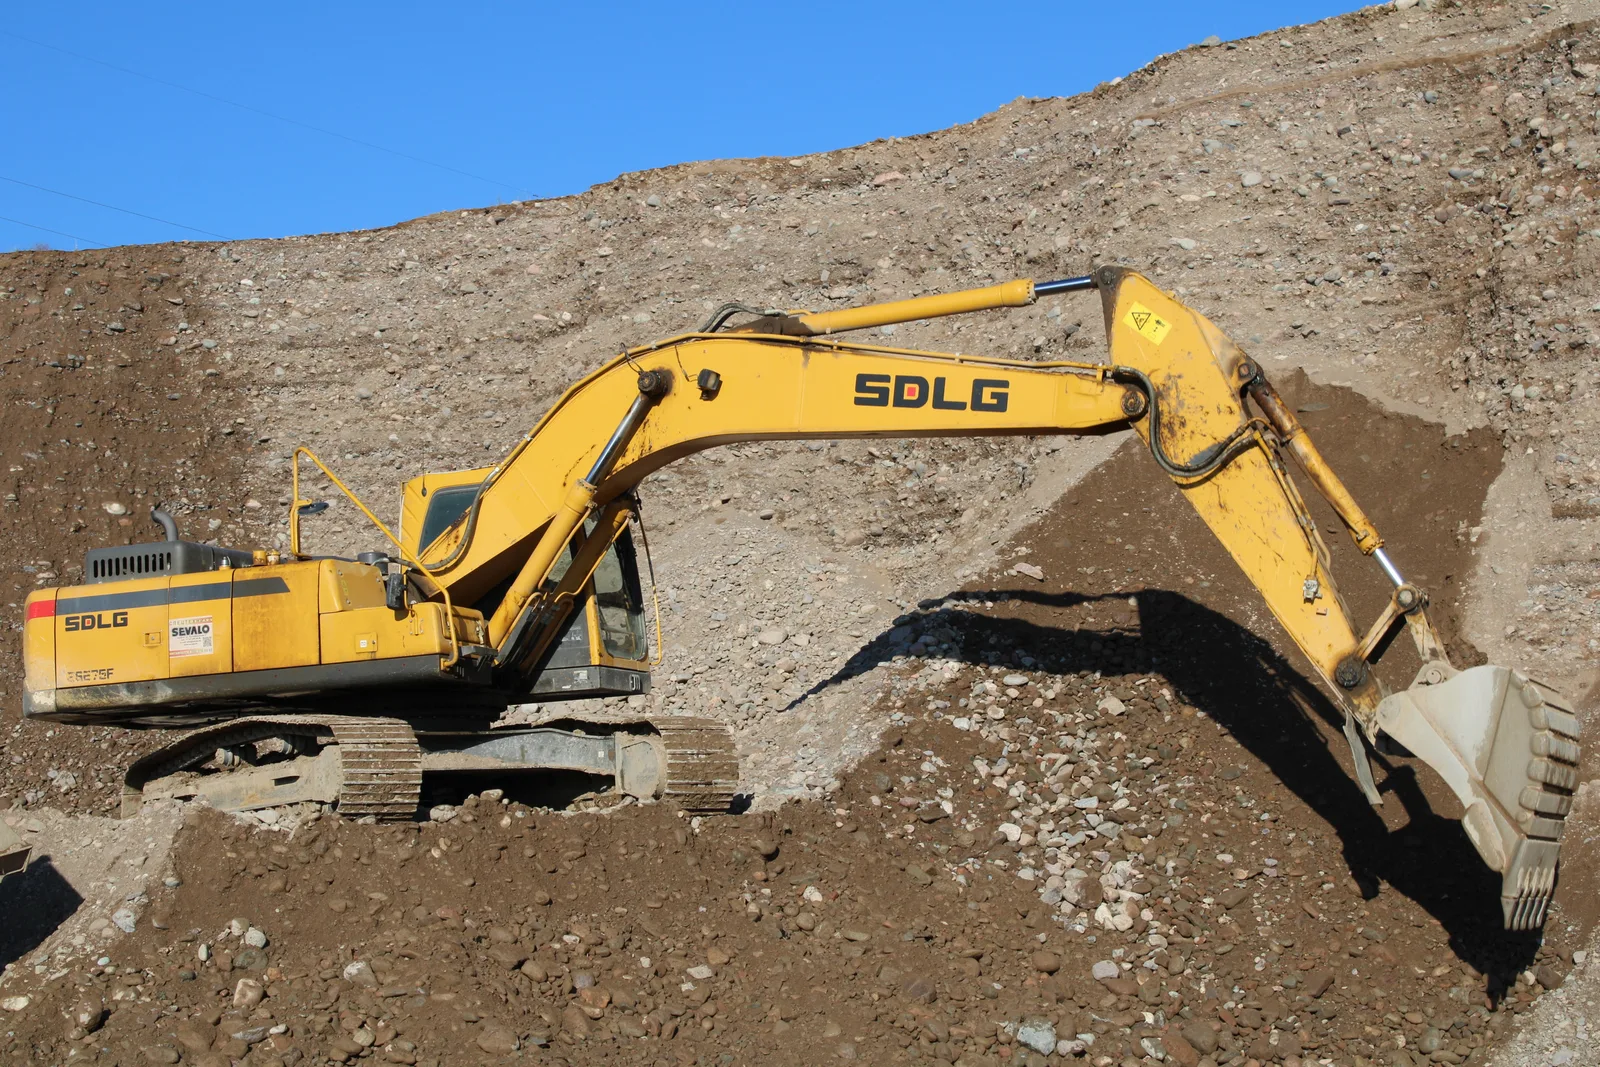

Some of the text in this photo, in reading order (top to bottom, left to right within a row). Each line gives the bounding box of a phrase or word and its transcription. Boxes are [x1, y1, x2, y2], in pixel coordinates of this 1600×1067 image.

[854, 373, 1010, 413] SDLG
[65, 612, 128, 632] SDLG
[171, 624, 210, 637] SEVALO
